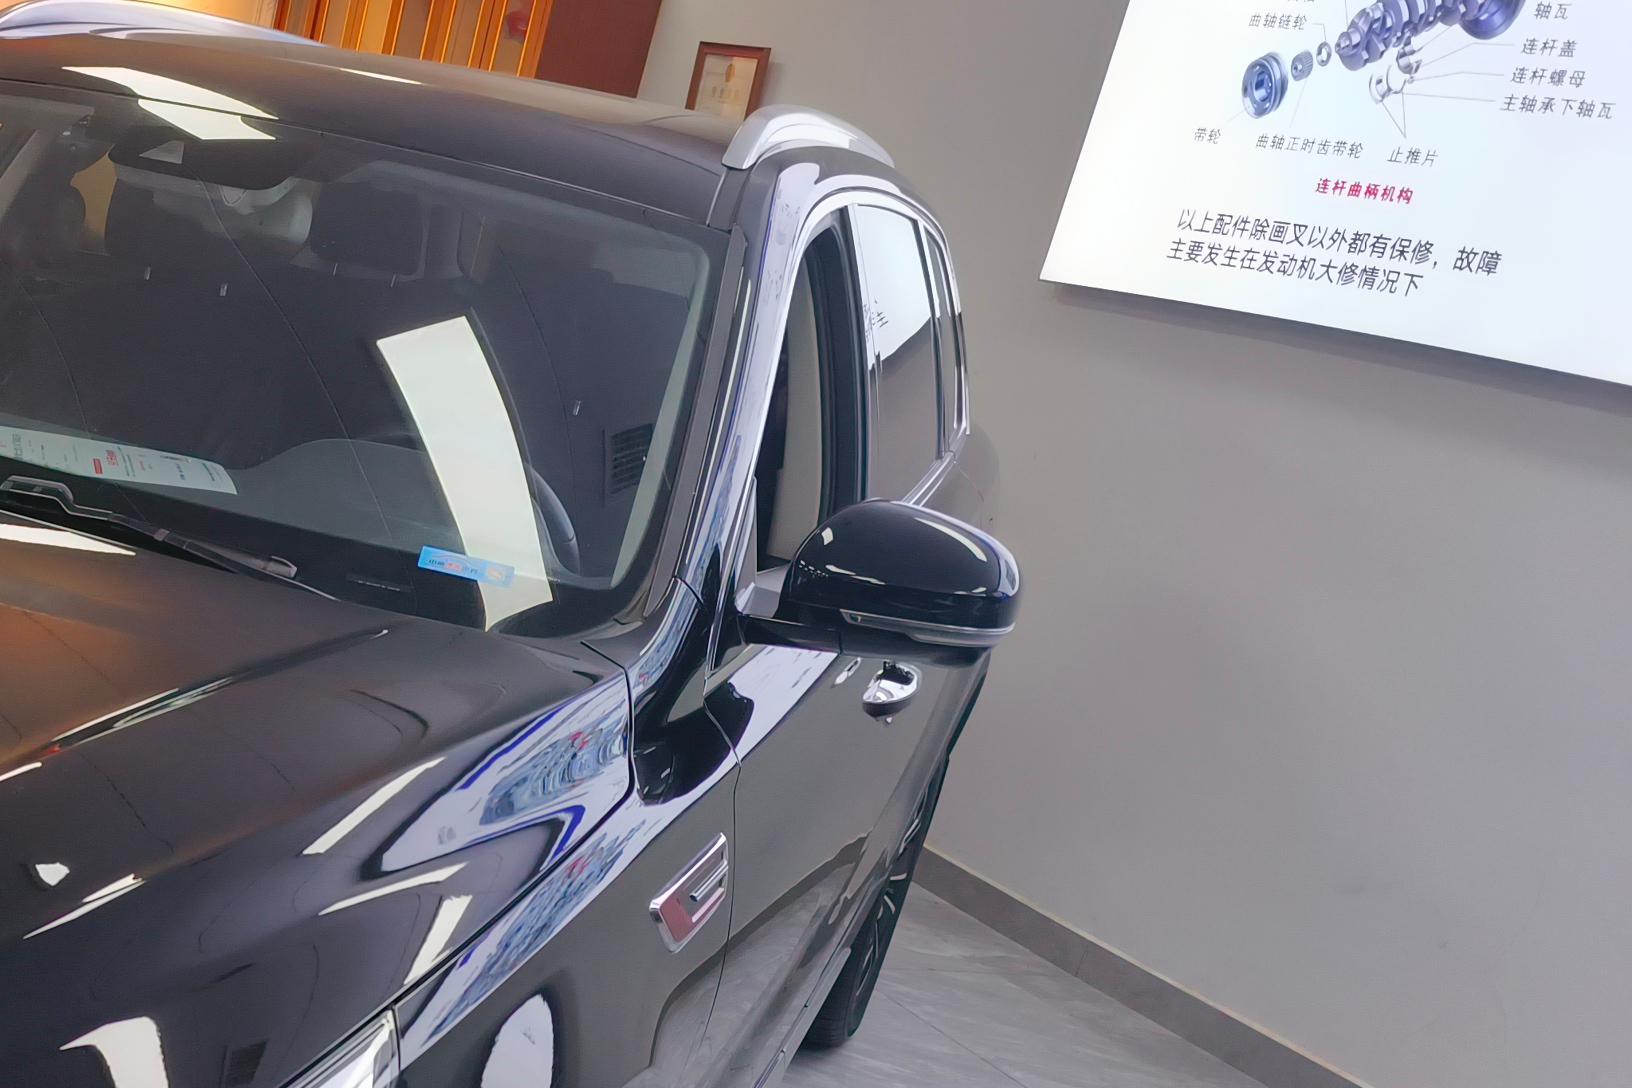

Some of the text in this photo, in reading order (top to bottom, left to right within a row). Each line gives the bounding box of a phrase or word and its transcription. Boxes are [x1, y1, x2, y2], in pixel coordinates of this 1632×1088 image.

[1249, 12, 1308, 31] 曲轴链轮
[1534, 1, 1572, 20] 轴瓦
[1520, 37, 1577, 58] 连杆盖
[1510, 66, 1586, 89] 连杆螺母
[1500, 94, 1616, 120] 主轴承下轴瓦
[1193, 127, 1222, 146] 带轮
[1255, 133, 1364, 160] 曲轴正时齿带轮
[1387, 147, 1439, 168] 止推片
[1315, 177, 1415, 205] 连杆曲柄机构
[1166, 238, 1425, 297] 主要发生在发动机大修情况下
